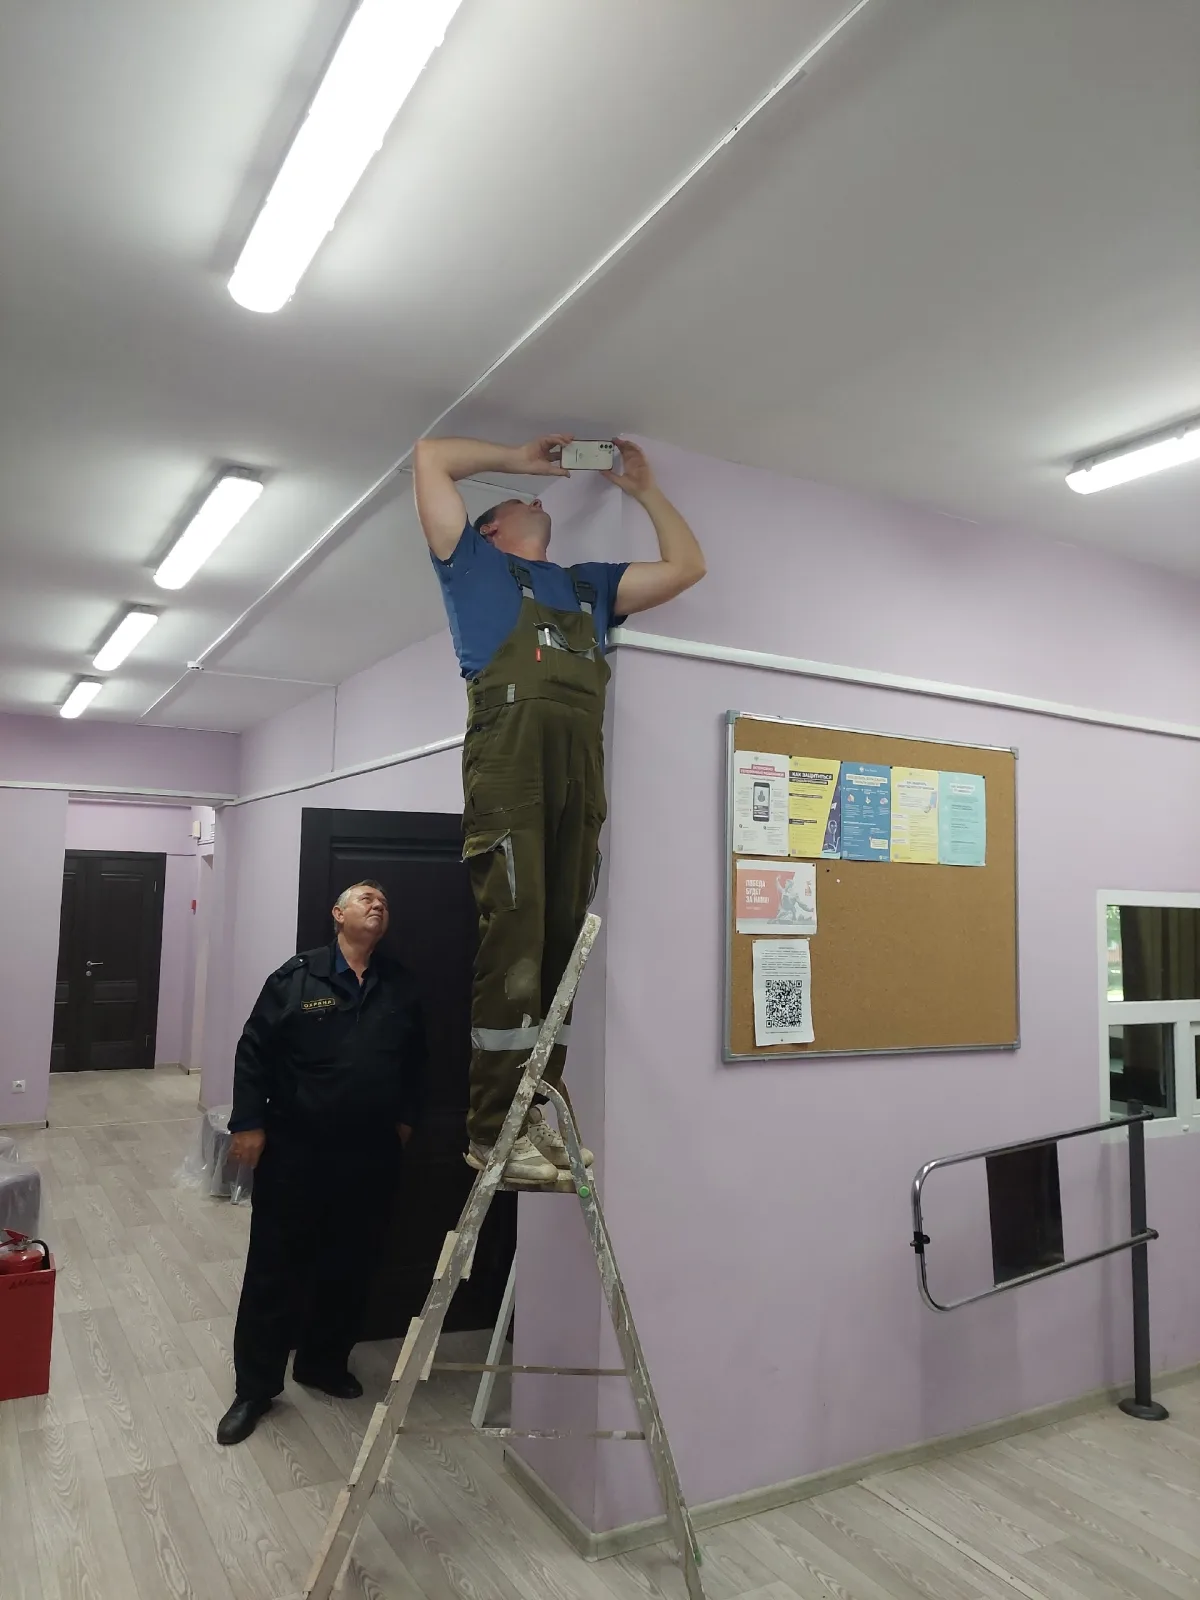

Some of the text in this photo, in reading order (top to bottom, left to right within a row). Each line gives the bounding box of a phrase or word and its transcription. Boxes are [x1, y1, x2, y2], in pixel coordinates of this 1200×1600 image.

[745, 879, 766, 888] ПОБЕДА
[745, 887, 762, 896] БУДЕТ
[745, 896, 753, 904] ЗА
[303, 1000, 332, 1008] ОХРАНА
